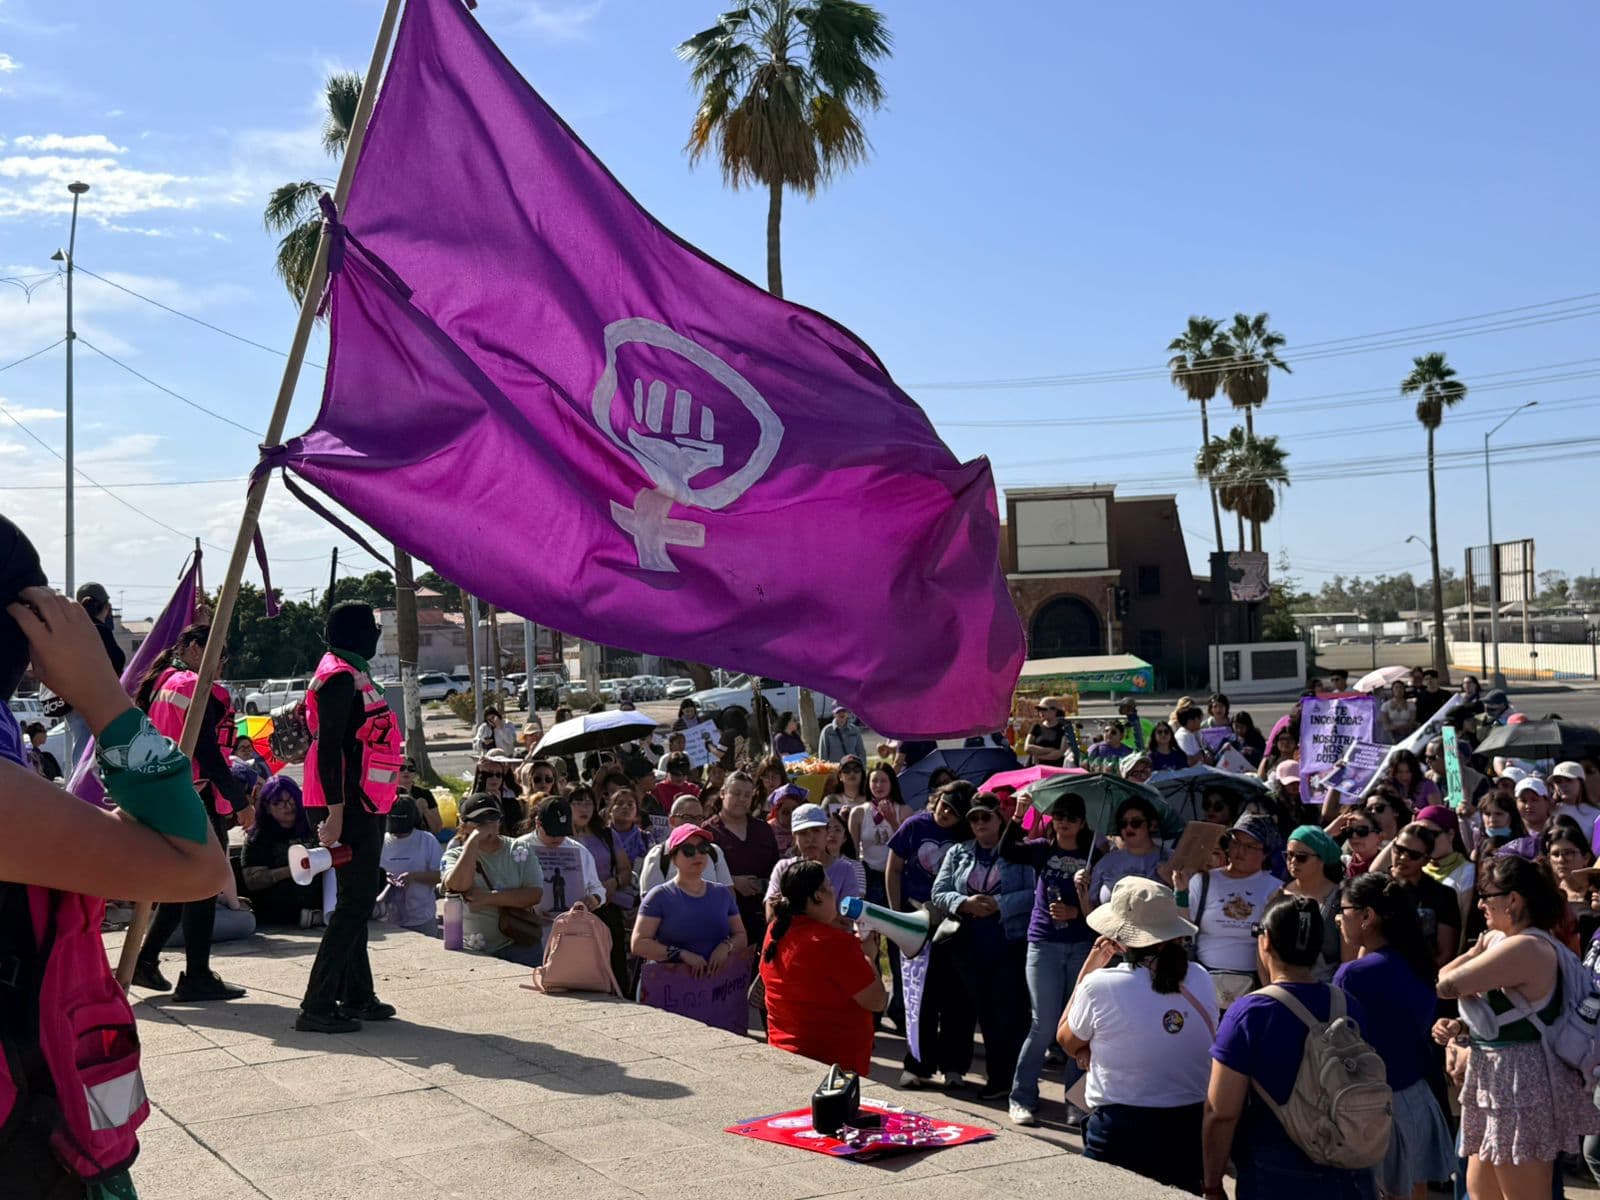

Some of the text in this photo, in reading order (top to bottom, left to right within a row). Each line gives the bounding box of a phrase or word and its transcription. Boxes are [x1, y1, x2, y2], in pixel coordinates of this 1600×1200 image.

[1331, 725, 1338, 735] A
[1312, 734, 1363, 746] NOSOTRA
[1323, 744, 1344, 754] NOS
